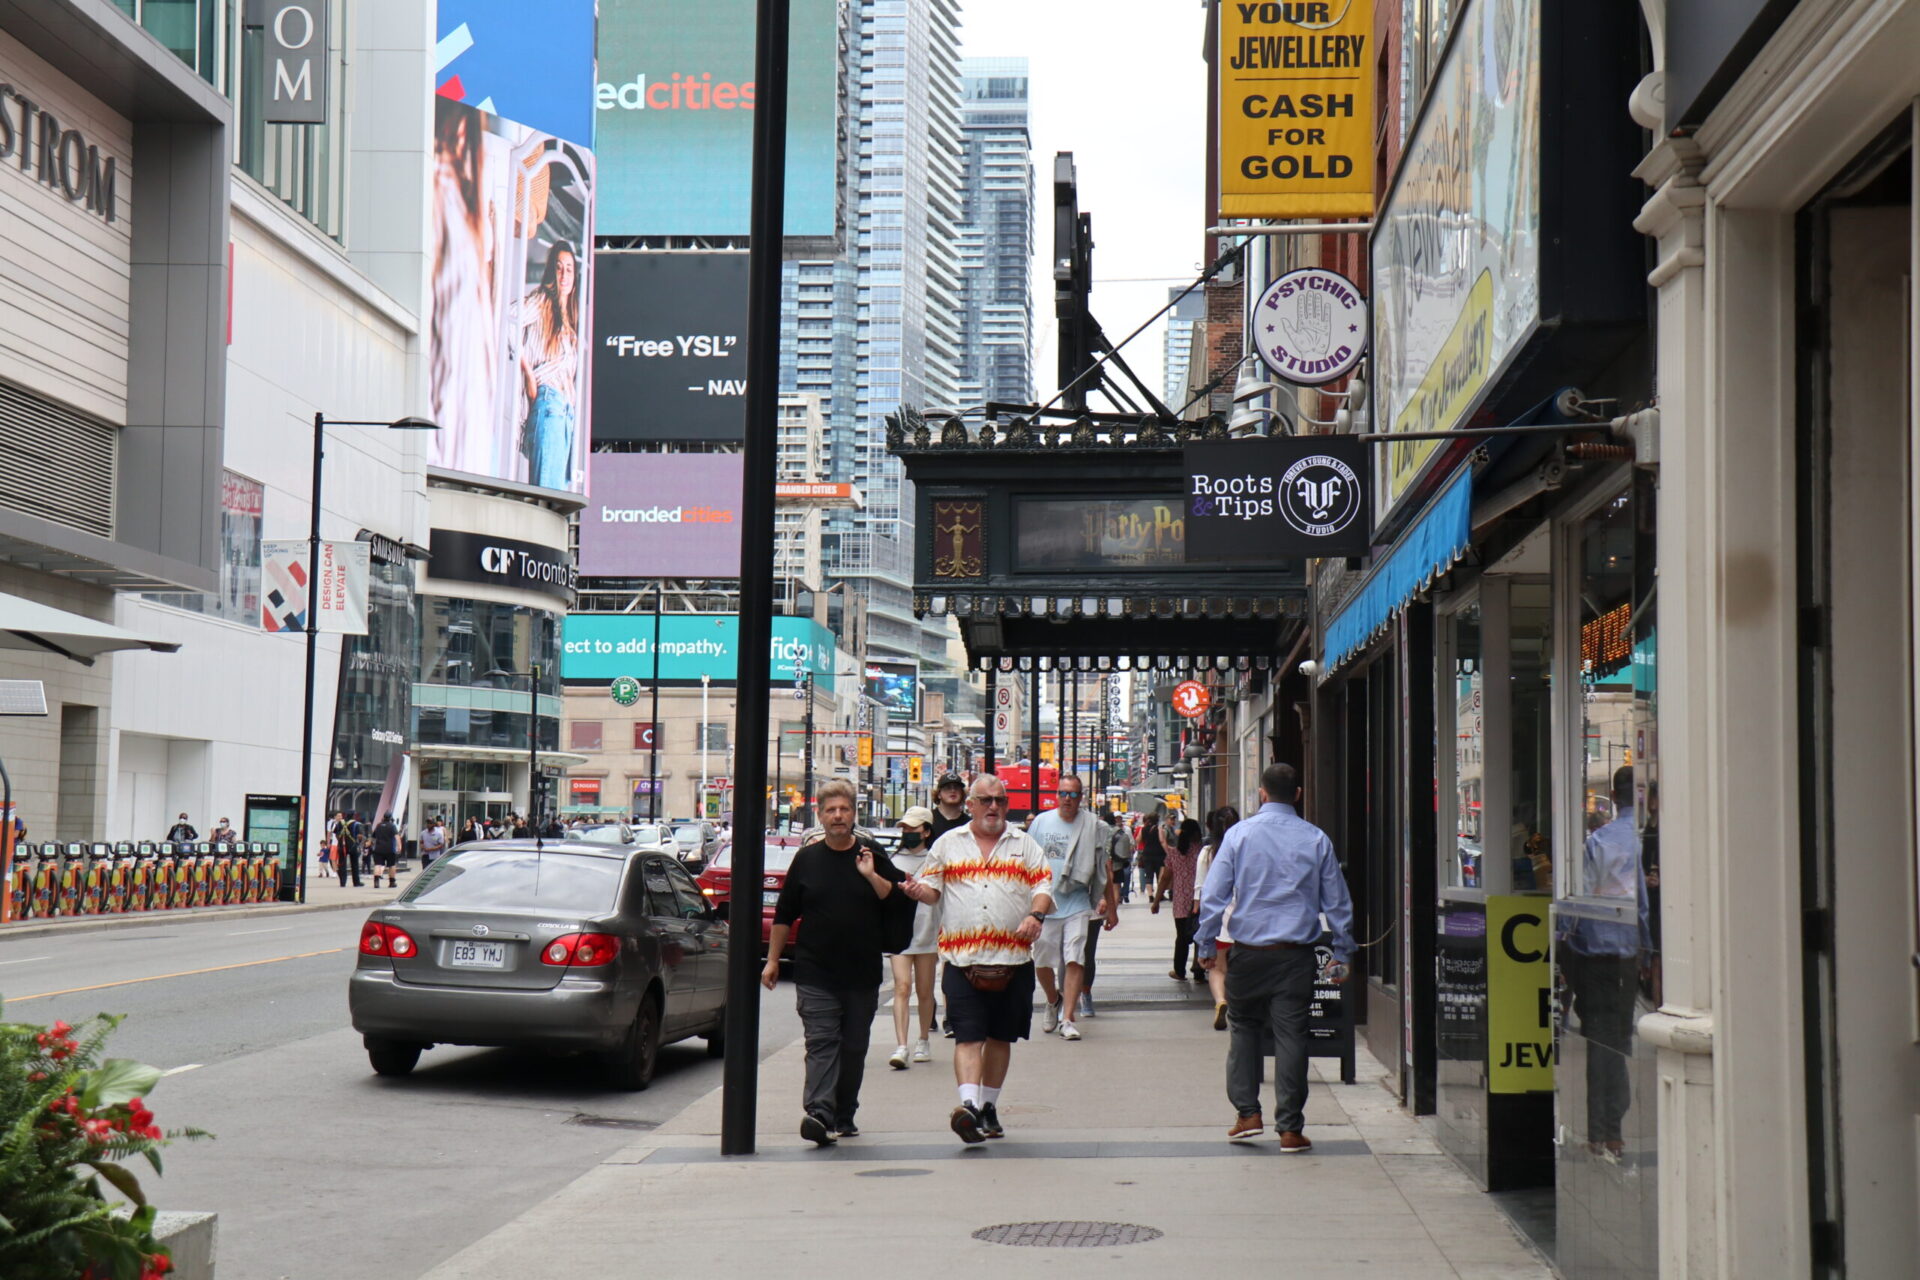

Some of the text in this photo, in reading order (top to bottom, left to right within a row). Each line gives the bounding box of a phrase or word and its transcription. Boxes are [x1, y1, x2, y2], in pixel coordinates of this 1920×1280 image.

[1237, 3, 1330, 24] YOUR
[1230, 35, 1365, 70] JEWELLERY
[1242, 94, 1353, 119] CASH
[1268, 129, 1325, 145] FOR
[1241, 155, 1353, 179] GOLD
[1265, 276, 1357, 311] PSYCHIC
[606, 336, 737, 357] “Free YSL”
[1270, 345, 1352, 374] STUDIO
[1438, 309, 1488, 421] Jewellery
[1308, 457, 1332, 466] YOUNG
[812, 485, 837, 495] CITIES
[1192, 474, 1273, 495] Roots
[602, 505, 733, 524] brandedcities
[1192, 496, 1273, 520] & Tips
[1305, 524, 1335, 535] STUDIO
[372, 535, 406, 567] SAMSUNG
[322, 543, 333, 610] DESIGN CAN
[481, 546, 515, 574] CF
[518, 551, 567, 586] Toronto
[336, 564, 346, 611] ELEVATE
[564, 638, 727, 657] ect to add empathy.
[620, 684, 631, 697] P
[1178, 706, 1203, 715] KITCHEN
[537, 922, 570, 930] COROLLA
[454, 946, 504, 962] E83 YMJ
